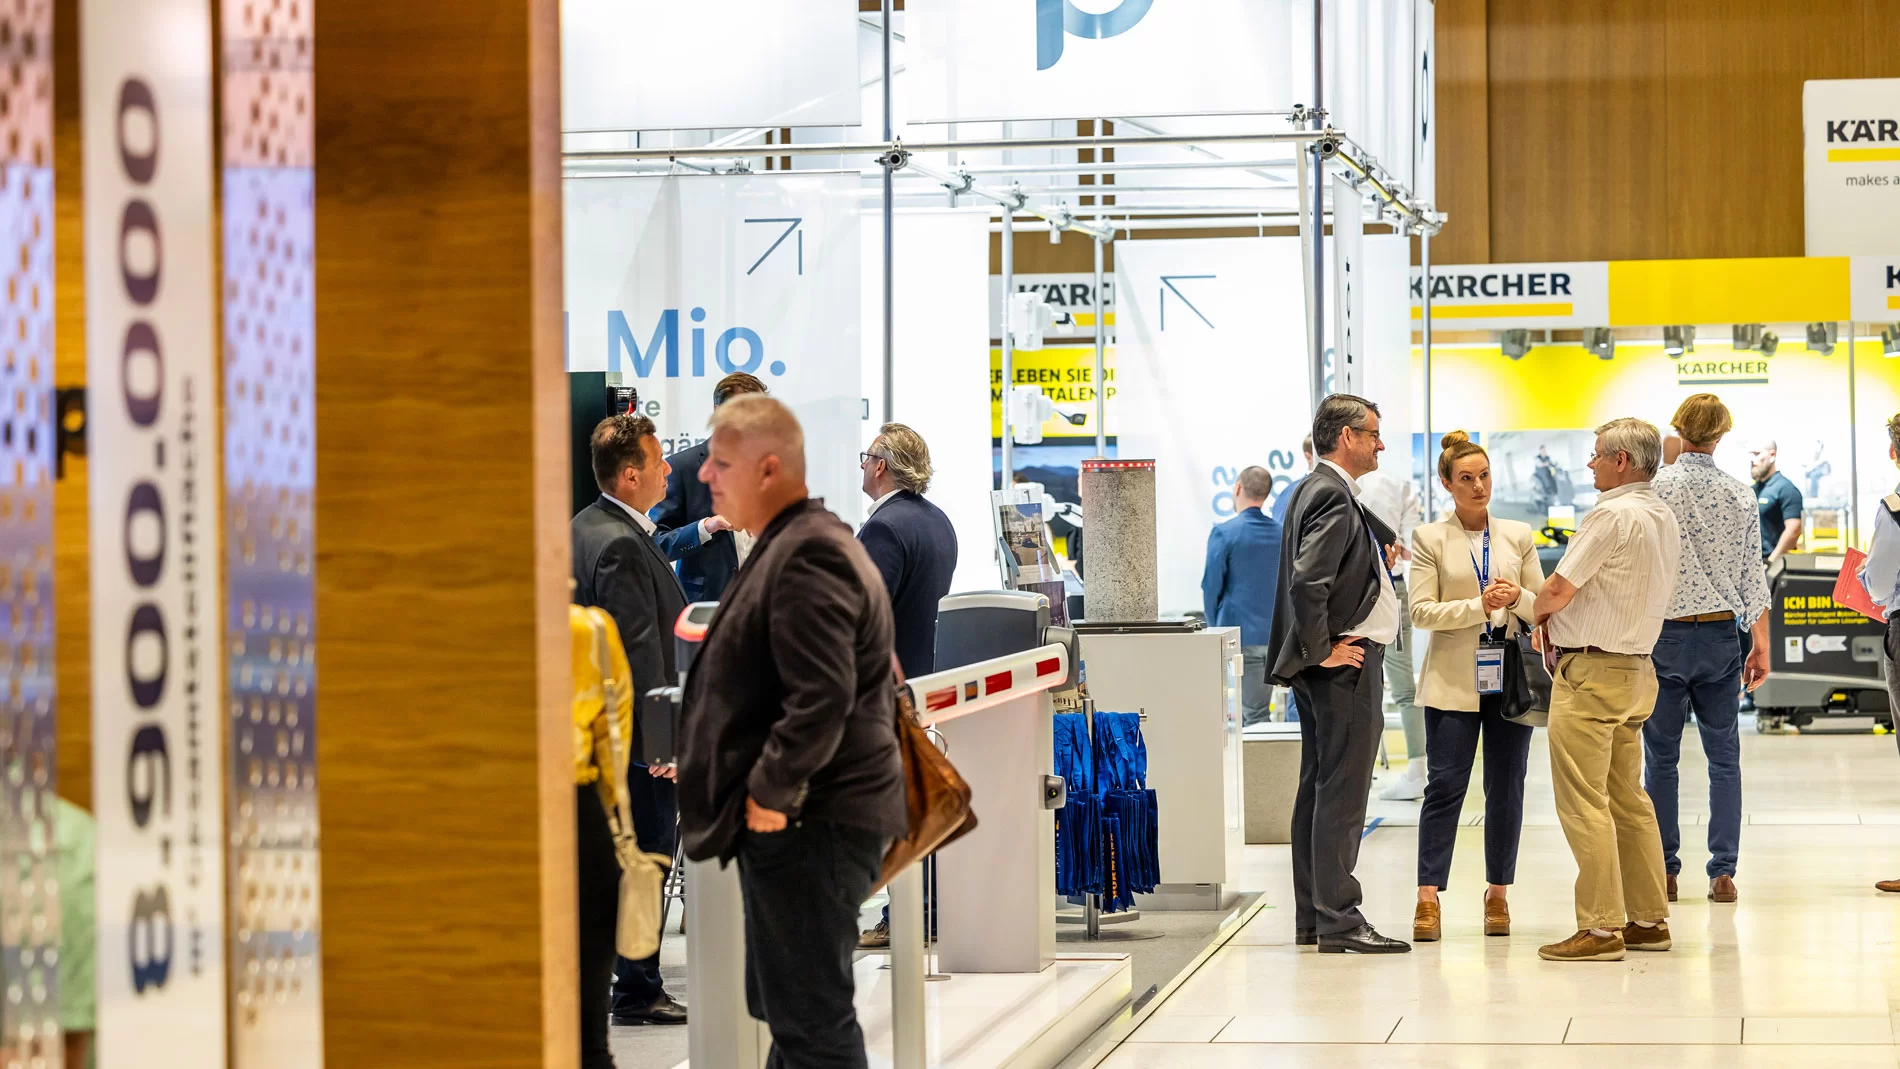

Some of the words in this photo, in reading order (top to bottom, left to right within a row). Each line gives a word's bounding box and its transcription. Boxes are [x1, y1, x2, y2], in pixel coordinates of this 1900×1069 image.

[1846, 174, 1889, 187] makes
[607, 306, 786, 378] Mio.
[1067, 368, 1091, 382] SIE
[116, 74, 174, 997] 8.900.000
[1783, 596, 1806, 610] ICH
[1807, 595, 1831, 609] BIN
